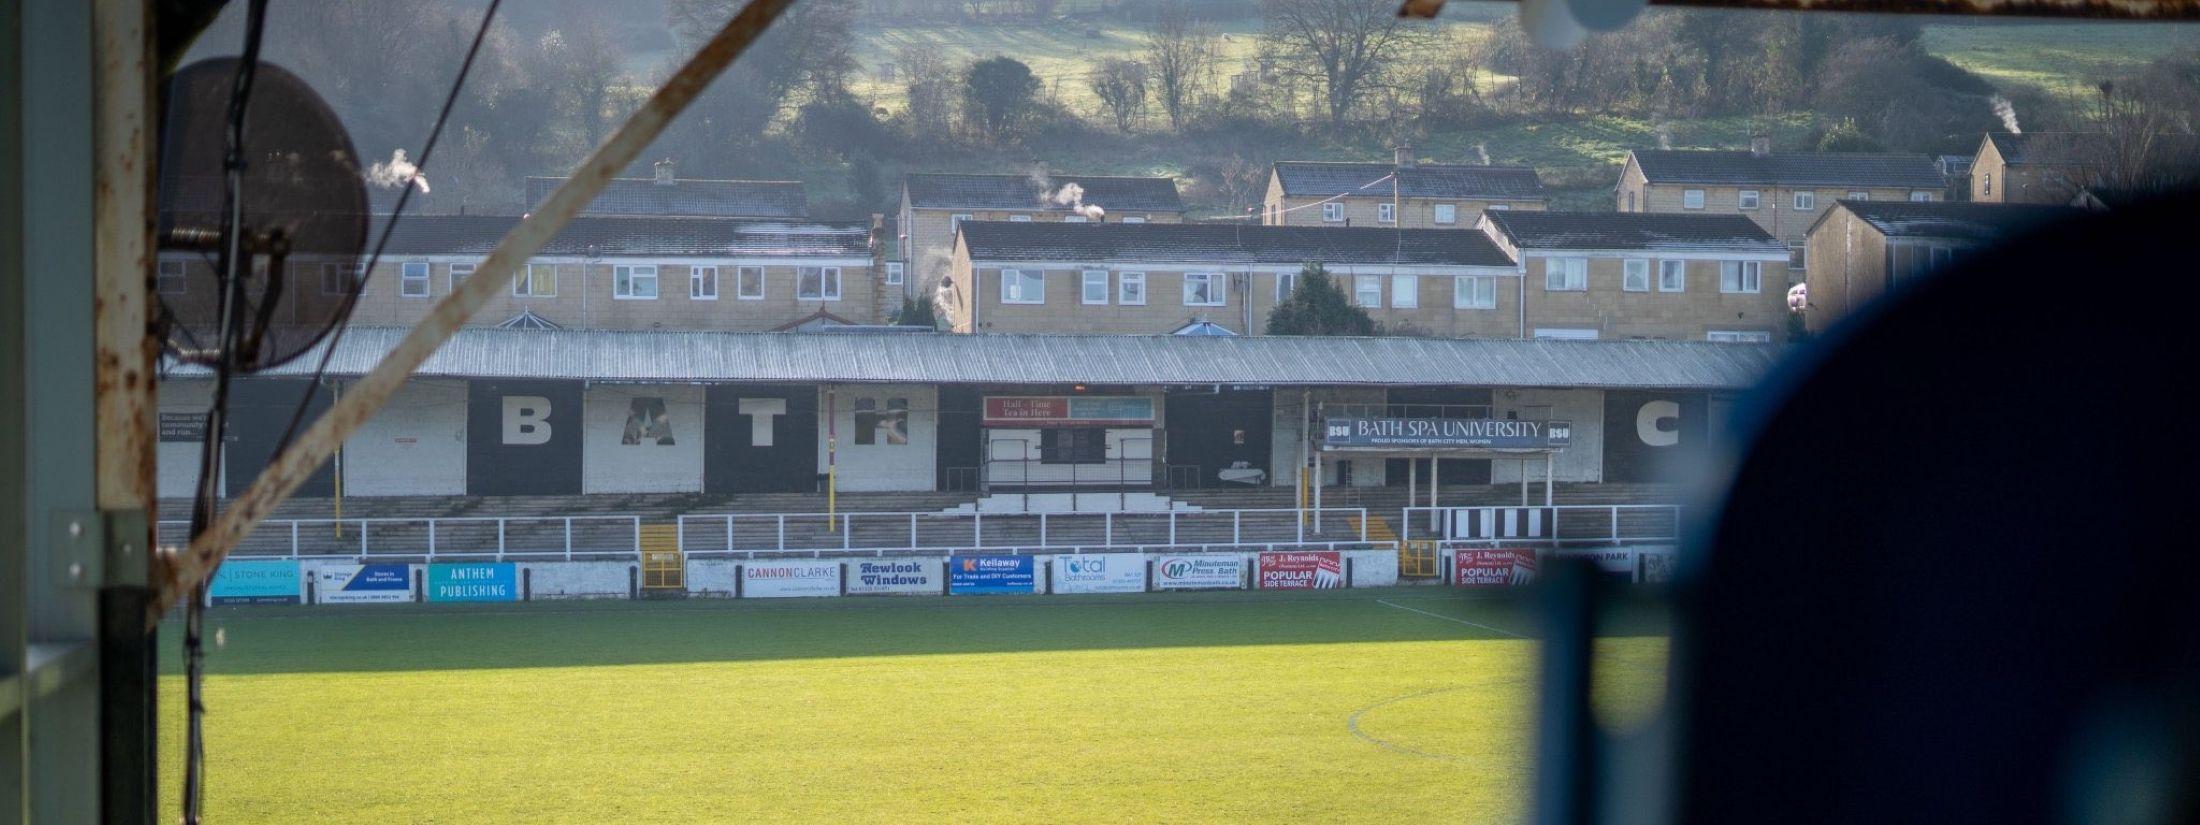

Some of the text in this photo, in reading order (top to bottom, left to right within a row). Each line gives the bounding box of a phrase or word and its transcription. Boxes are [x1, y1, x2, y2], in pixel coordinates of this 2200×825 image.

[1004, 408, 1018, 416] Tea
[1030, 408, 1050, 416] Here
[1637, 400, 1680, 446] C
[1328, 425, 1350, 437] BSU
[1358, 420, 1541, 437] BATH SPA UNIVERSITY
[1549, 427, 1570, 439] BSU
[1288, 554, 1319, 563] Reynolds
[1484, 551, 1515, 560] Reynolds
[1605, 552, 1628, 560] PARK
[860, 562, 921, 573] Newlook
[980, 558, 1020, 568] Kellaway
[1059, 556, 1105, 573] Total
[234, 569, 265, 578] STONE
[270, 568, 294, 578] KING
[450, 568, 494, 580] ANTHEM
[748, 567, 835, 578] CANNONCLARKE
[1264, 570, 1313, 580] POPULAR
[1461, 567, 1509, 577] POPULAR
[861, 575, 927, 585] Windows
[1064, 574, 1105, 582] Bathrooms
[440, 585, 506, 598] PUBLISHING
